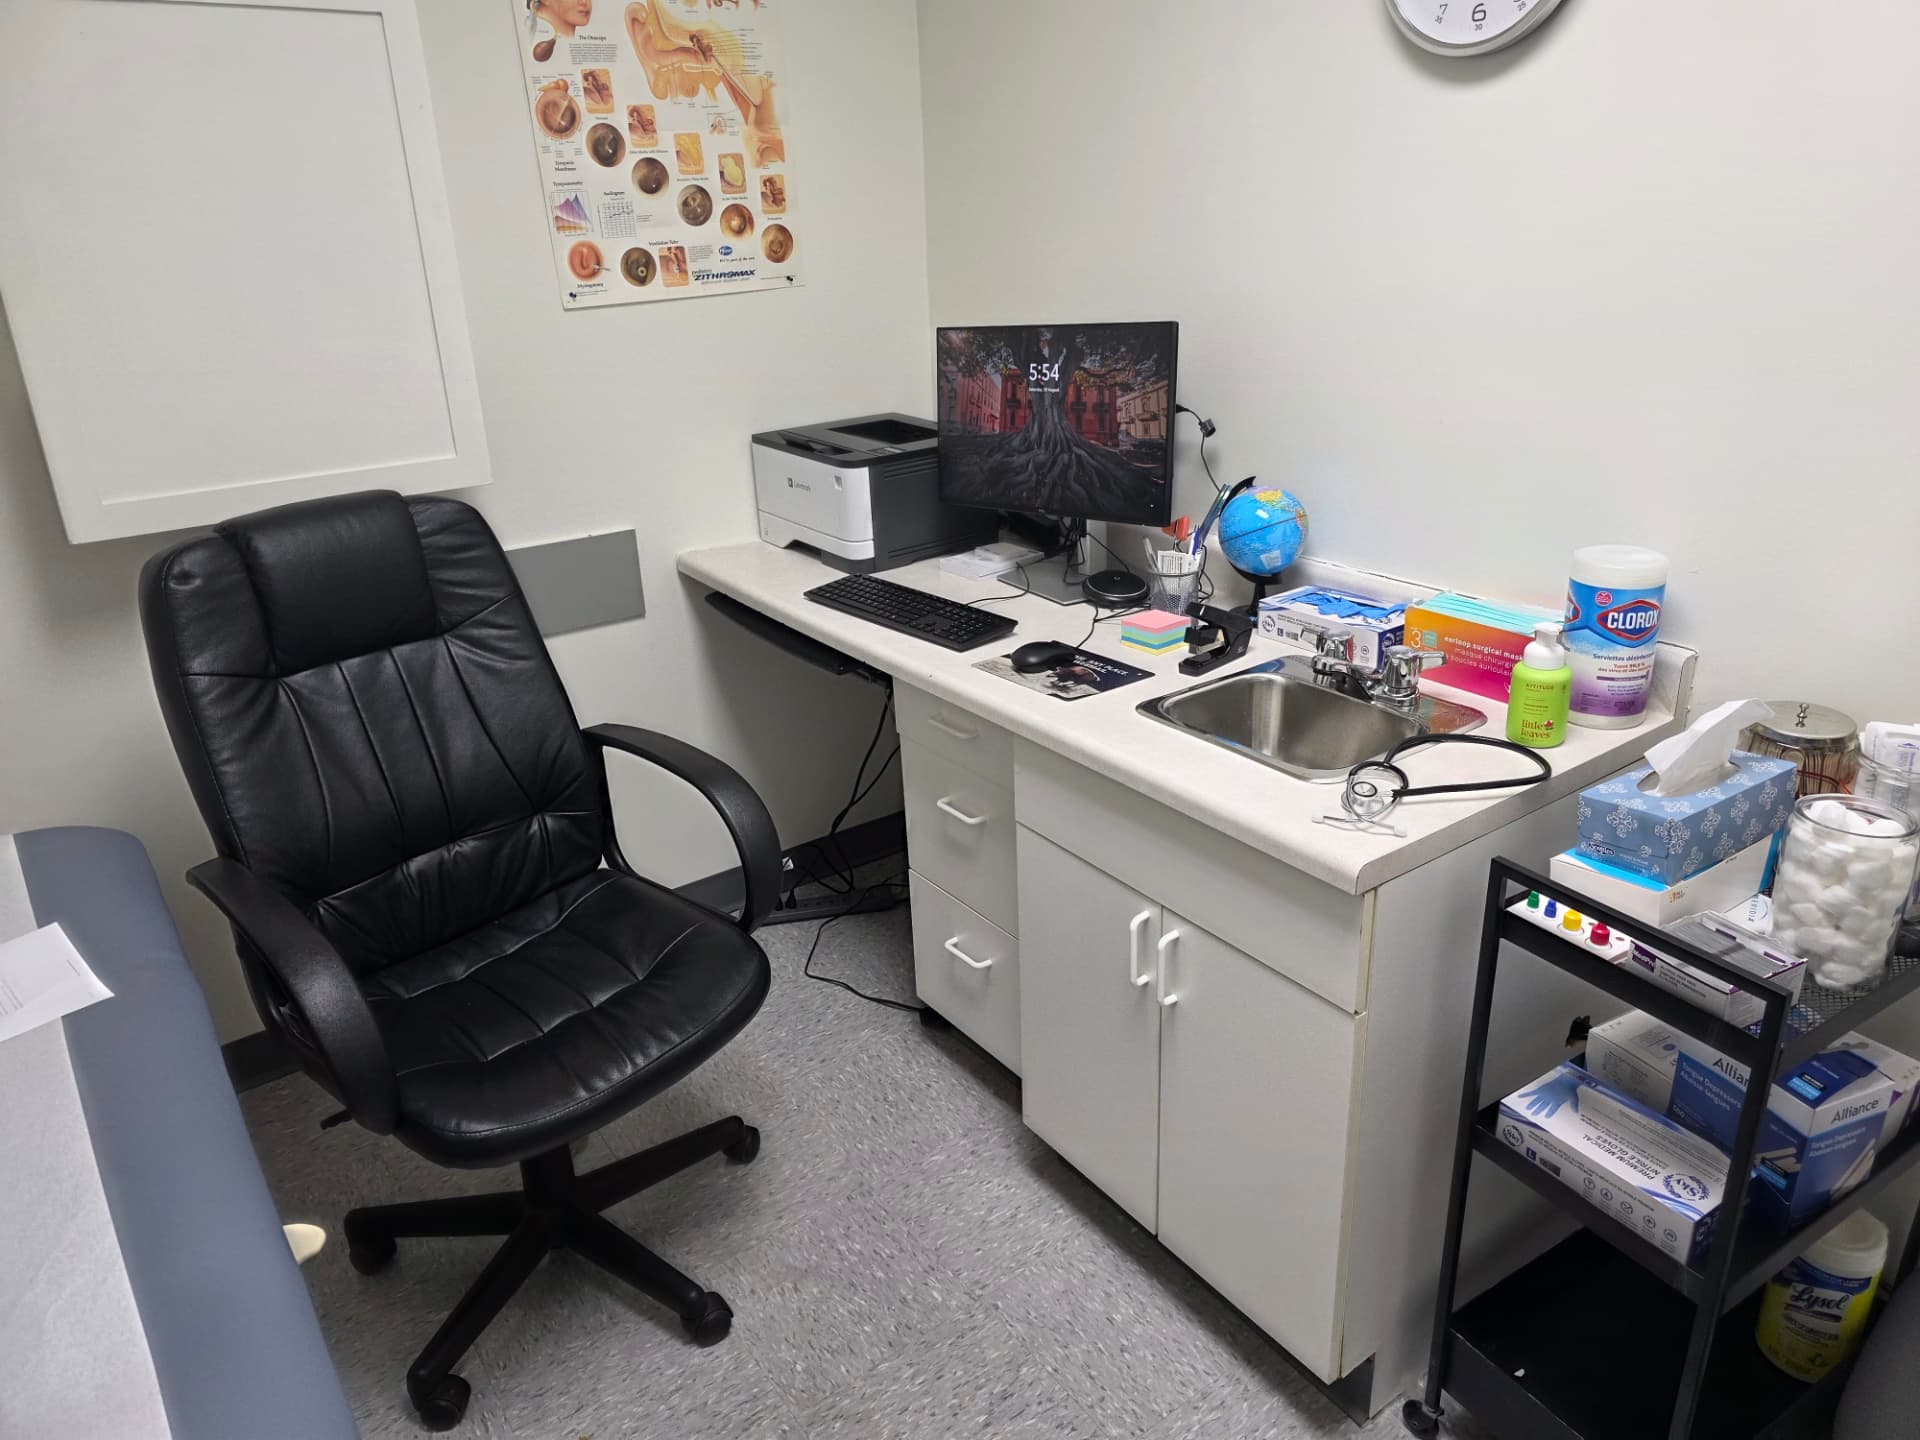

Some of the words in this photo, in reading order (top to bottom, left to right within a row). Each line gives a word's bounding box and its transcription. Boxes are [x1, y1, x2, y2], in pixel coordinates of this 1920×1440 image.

[1440, 4, 1448, 14] 7
[1472, 3, 1486, 22] 6
[694, 269, 756, 281] ZITHROMAX
[1029, 363, 1059, 381] 5:54
[1607, 610, 1659, 629] CLOROX
[1411, 630, 1421, 648] 3
[1444, 636, 1471, 648] earloop
[1472, 643, 1502, 655] surgical
[1451, 655, 1477, 667] boucles
[1455, 648, 1481, 660] masque
[1521, 728, 1551, 738] leaves
[1522, 720, 1543, 730] little
[1713, 1058, 1750, 1086] Allian
[1831, 1099, 1879, 1124] Alliance
[1583, 1135, 1617, 1158] MEDICAL
[1596, 1135, 1629, 1157] GLOVES
[1616, 1156, 1655, 1180] PREMIUM
[1630, 1153, 1661, 1176] NITRILE
[1674, 1178, 1700, 1198] Sky
[1791, 1286, 1850, 1310] Lysol
